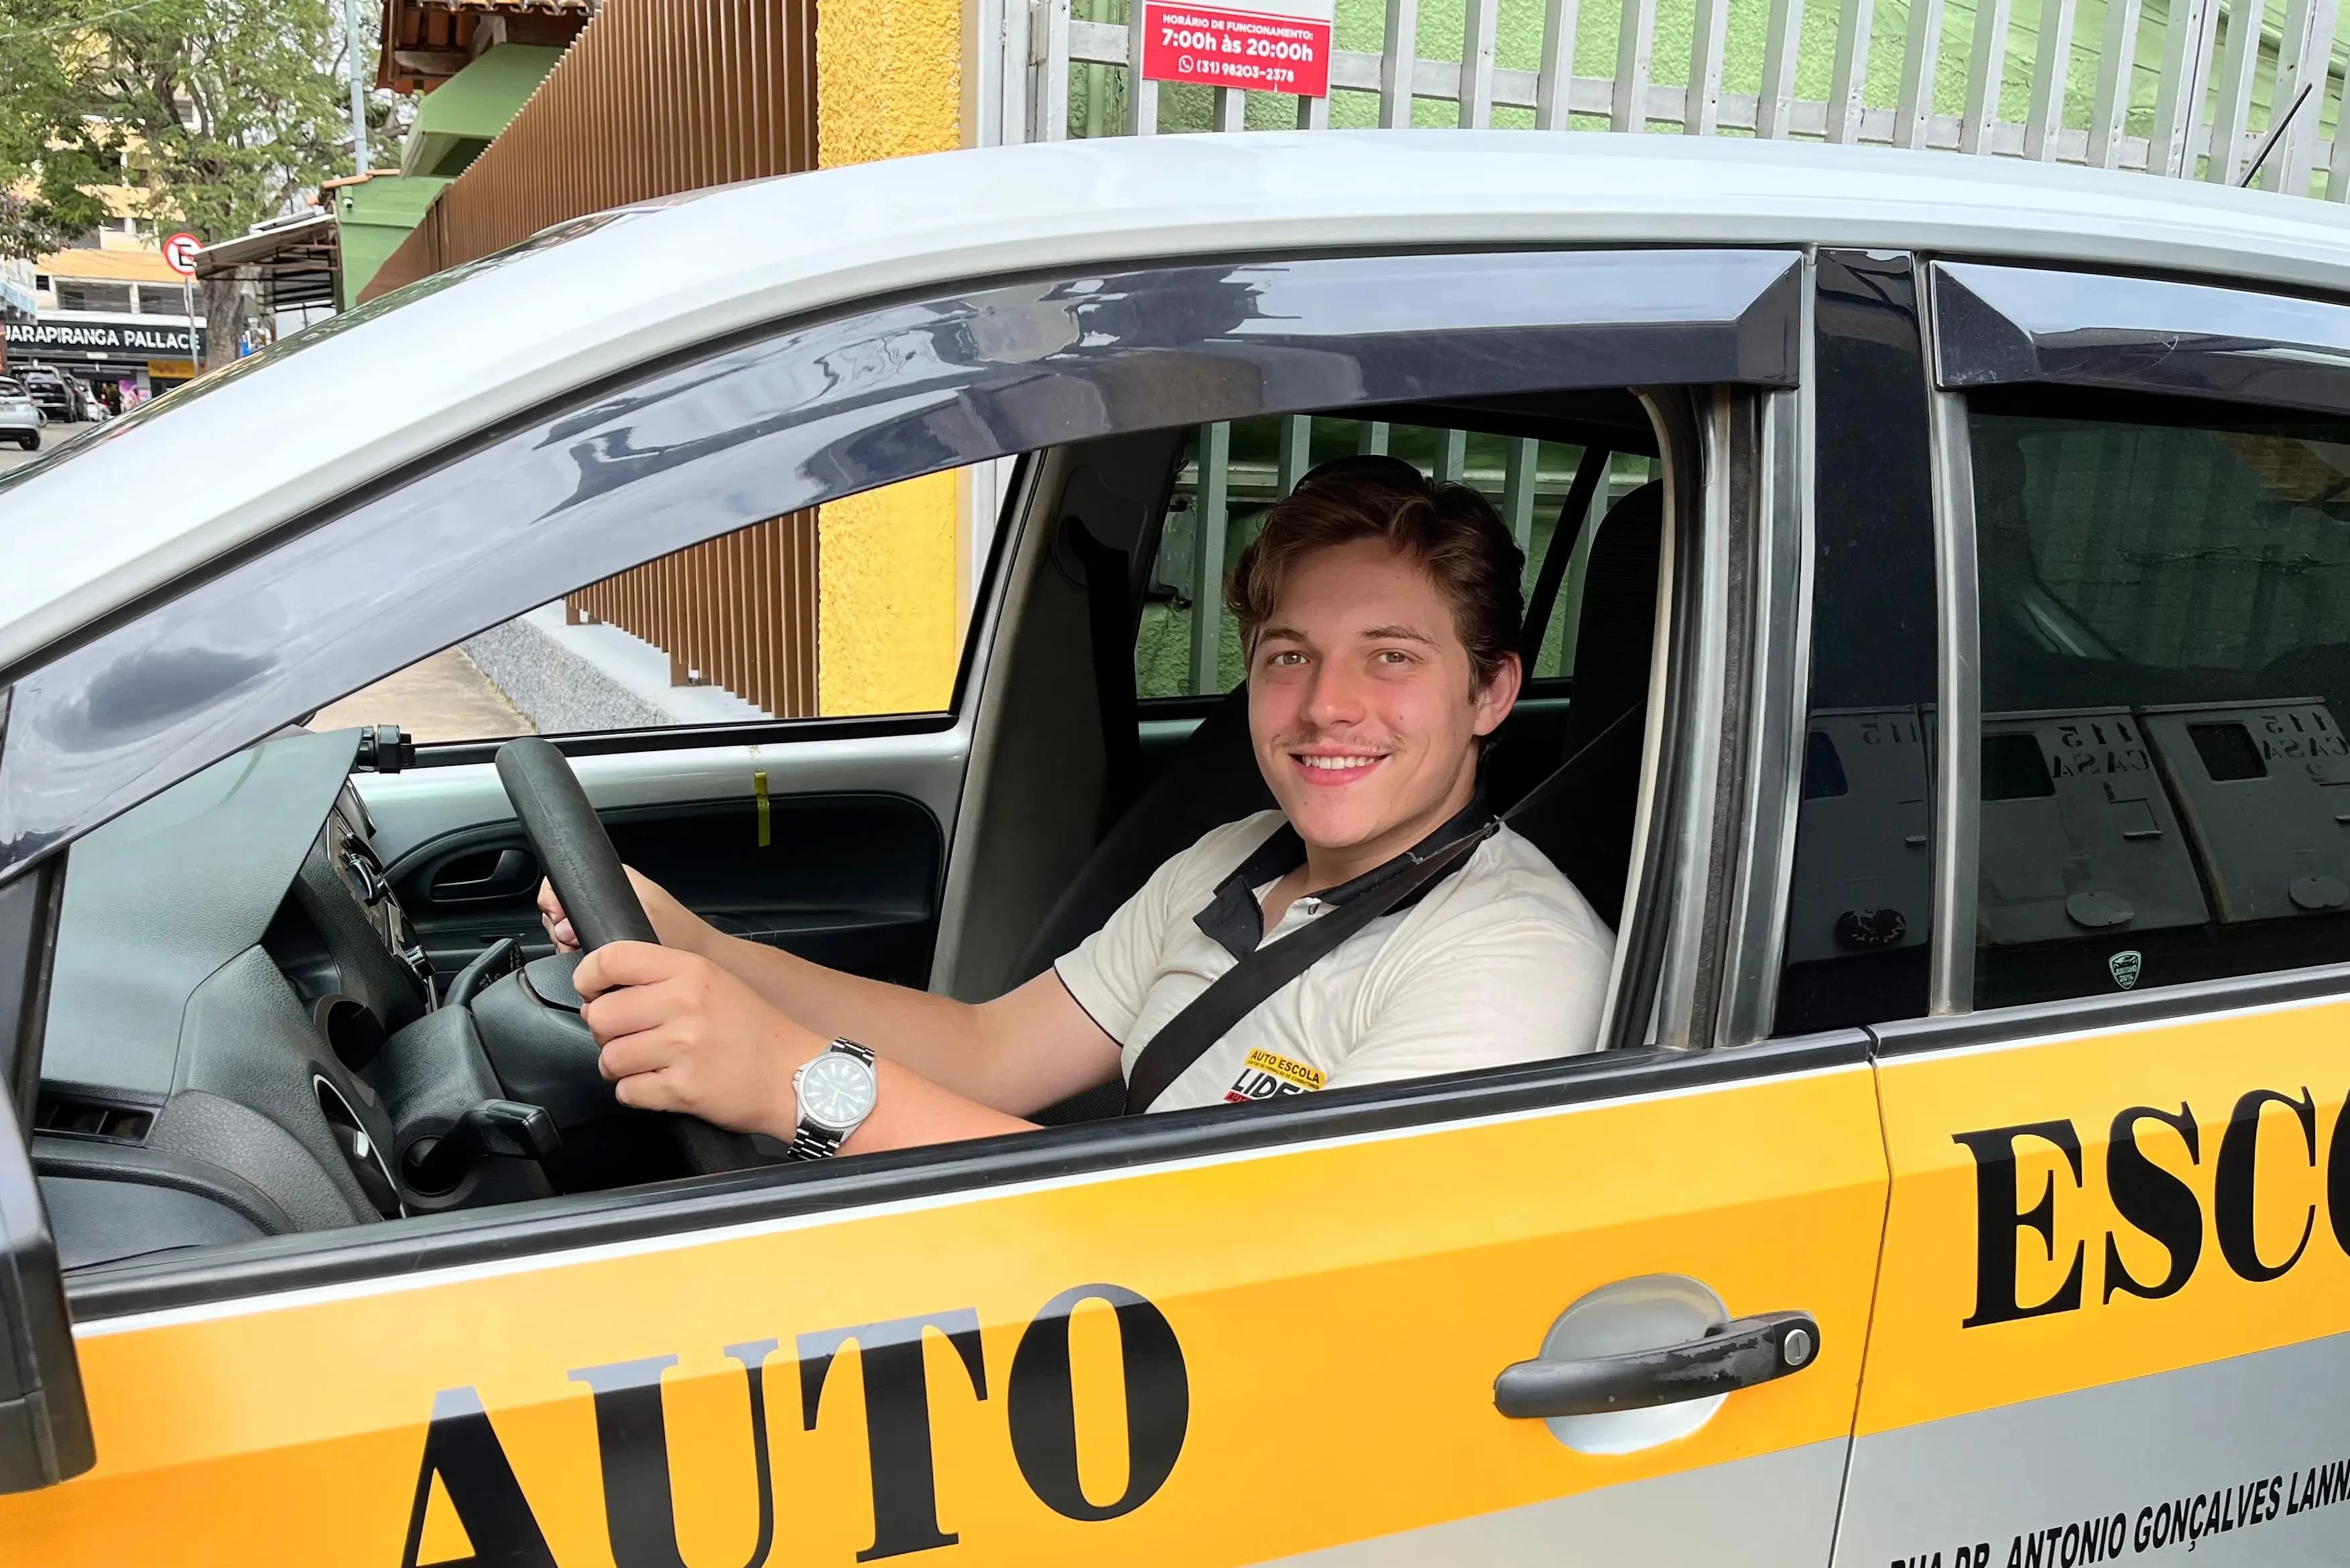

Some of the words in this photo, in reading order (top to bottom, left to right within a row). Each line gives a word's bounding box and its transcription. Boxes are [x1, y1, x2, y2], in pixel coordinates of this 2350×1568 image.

[1163, 14, 1209, 28] HORÁRIO
[1211, 19, 1225, 30] DE
[1227, 21, 1314, 40] FUNCIONAMENTO:
[1161, 28, 1217, 51] 7:00h
[1221, 34, 1242, 54] às
[1246, 38, 1313, 62] 20:00h
[1196, 60, 1220, 75] (31)
[1222, 62, 1294, 82] 98203-2378
[124, 328, 200, 350] PALLACE
[1231, 1068, 1312, 1098] LIDE
[1251, 1050, 1276, 1065] AUTO
[1278, 1059, 1320, 1084] ESCOLA
[400, 1283, 1189, 1568] AUTO
[1951, 1086, 2350, 1329] ESC
[2006, 1512, 2127, 1568] ANTONIO
[2134, 1476, 2283, 1553] GONÇALVES
[2286, 1458, 2350, 1516] LANN
